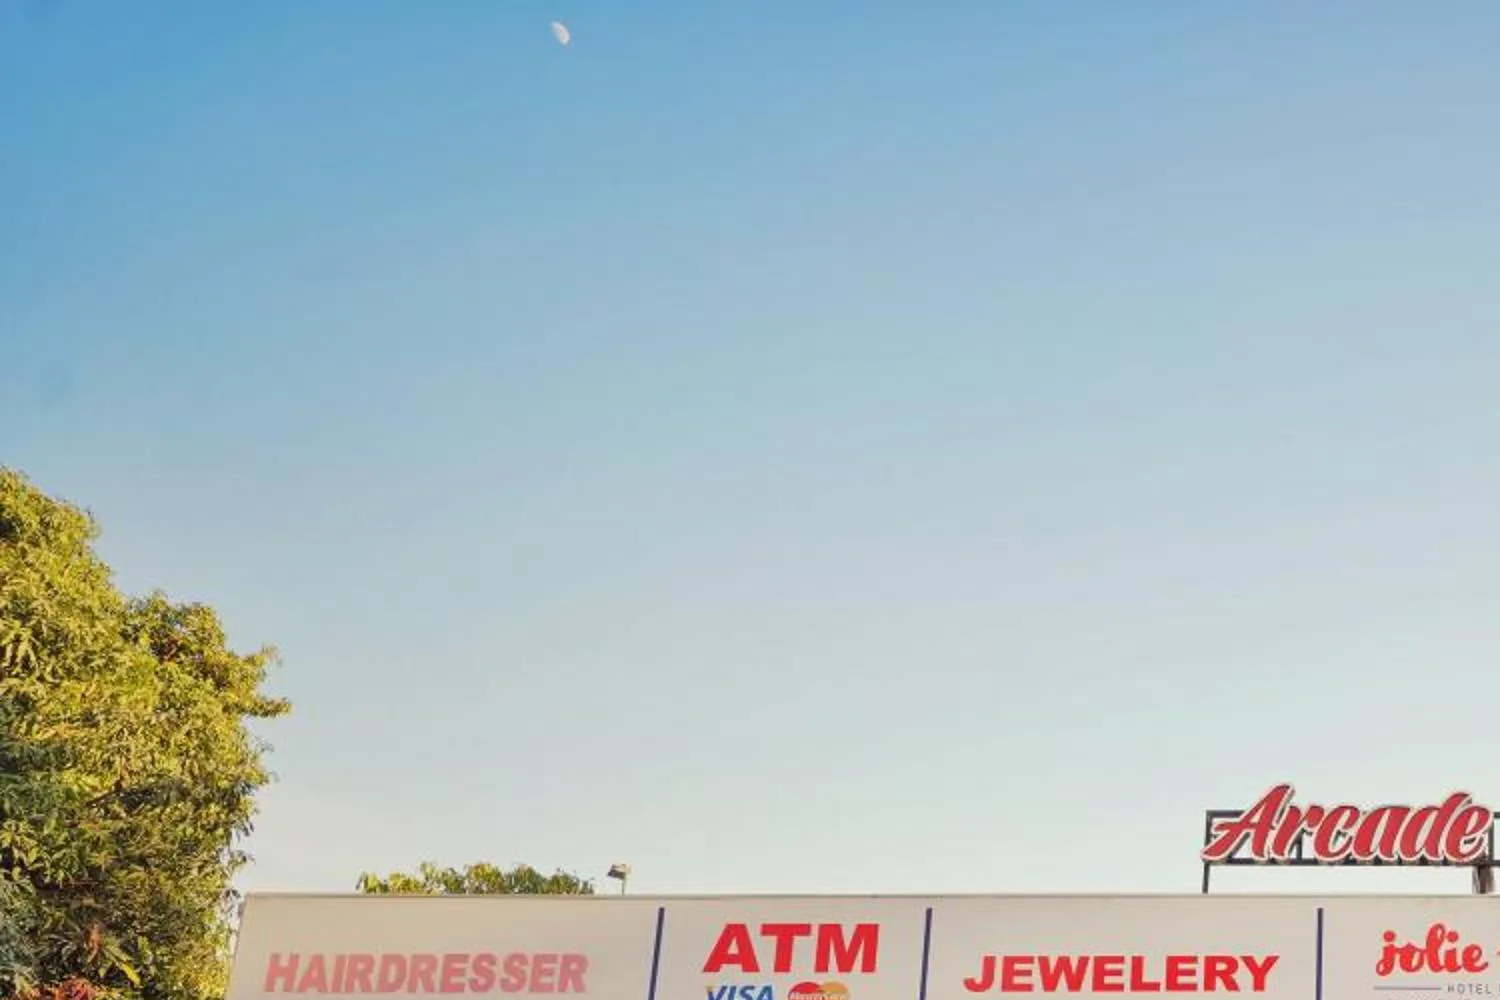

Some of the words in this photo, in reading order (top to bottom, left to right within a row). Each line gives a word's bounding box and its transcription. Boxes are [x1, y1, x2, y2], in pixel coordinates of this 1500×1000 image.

[1201, 783, 1491, 861] Arcade
[703, 923, 880, 974] ATM
[1375, 923, 1489, 977] jolie
[263, 952, 589, 993] HAIRDRESSER
[963, 954, 1279, 993] JEWELERY
[1447, 984, 1493, 995] HOTEL
